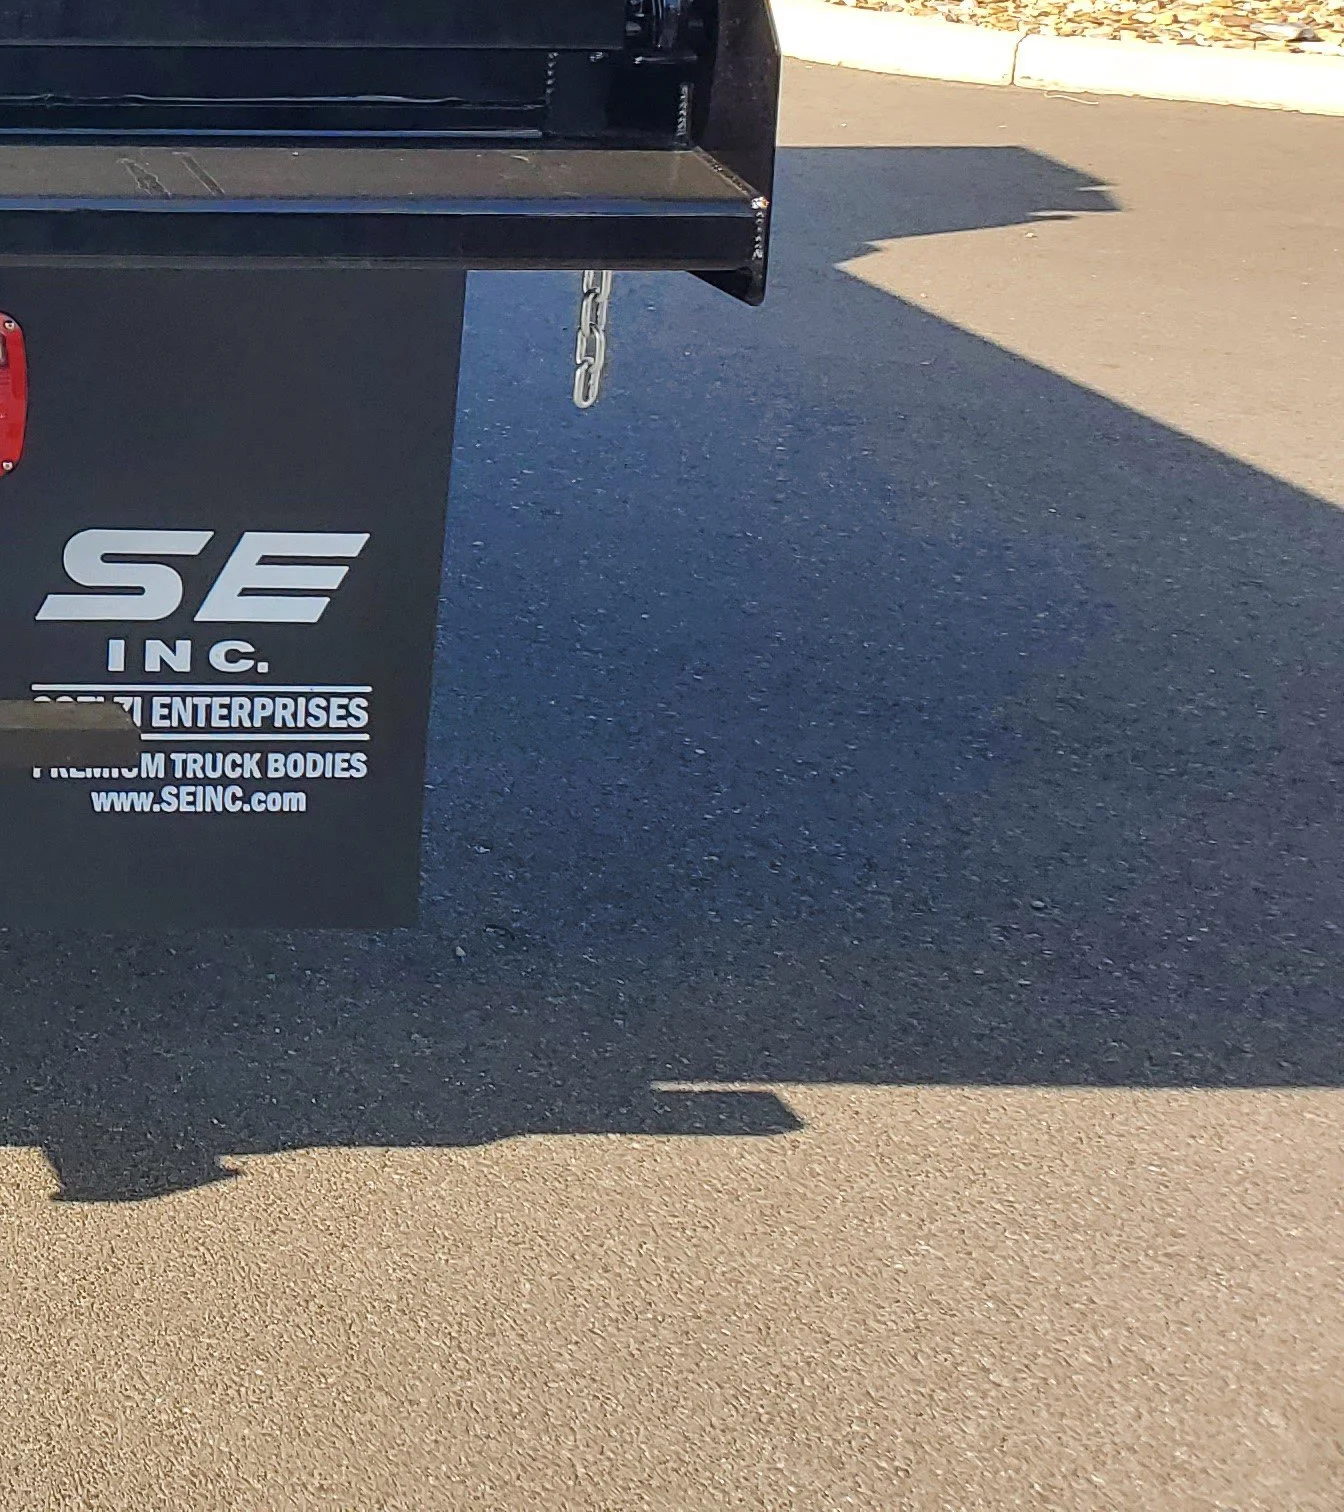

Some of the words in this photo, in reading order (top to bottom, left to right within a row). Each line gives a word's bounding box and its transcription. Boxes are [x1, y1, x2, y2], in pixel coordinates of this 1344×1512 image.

[35, 529, 370, 623] SE
[107, 639, 269, 673] INC.
[151, 696, 370, 728] ENTERPRISES
[170, 752, 263, 779] TRUCK
[267, 752, 368, 779] BODIES
[90, 785, 307, 813] www.SEINC.com
